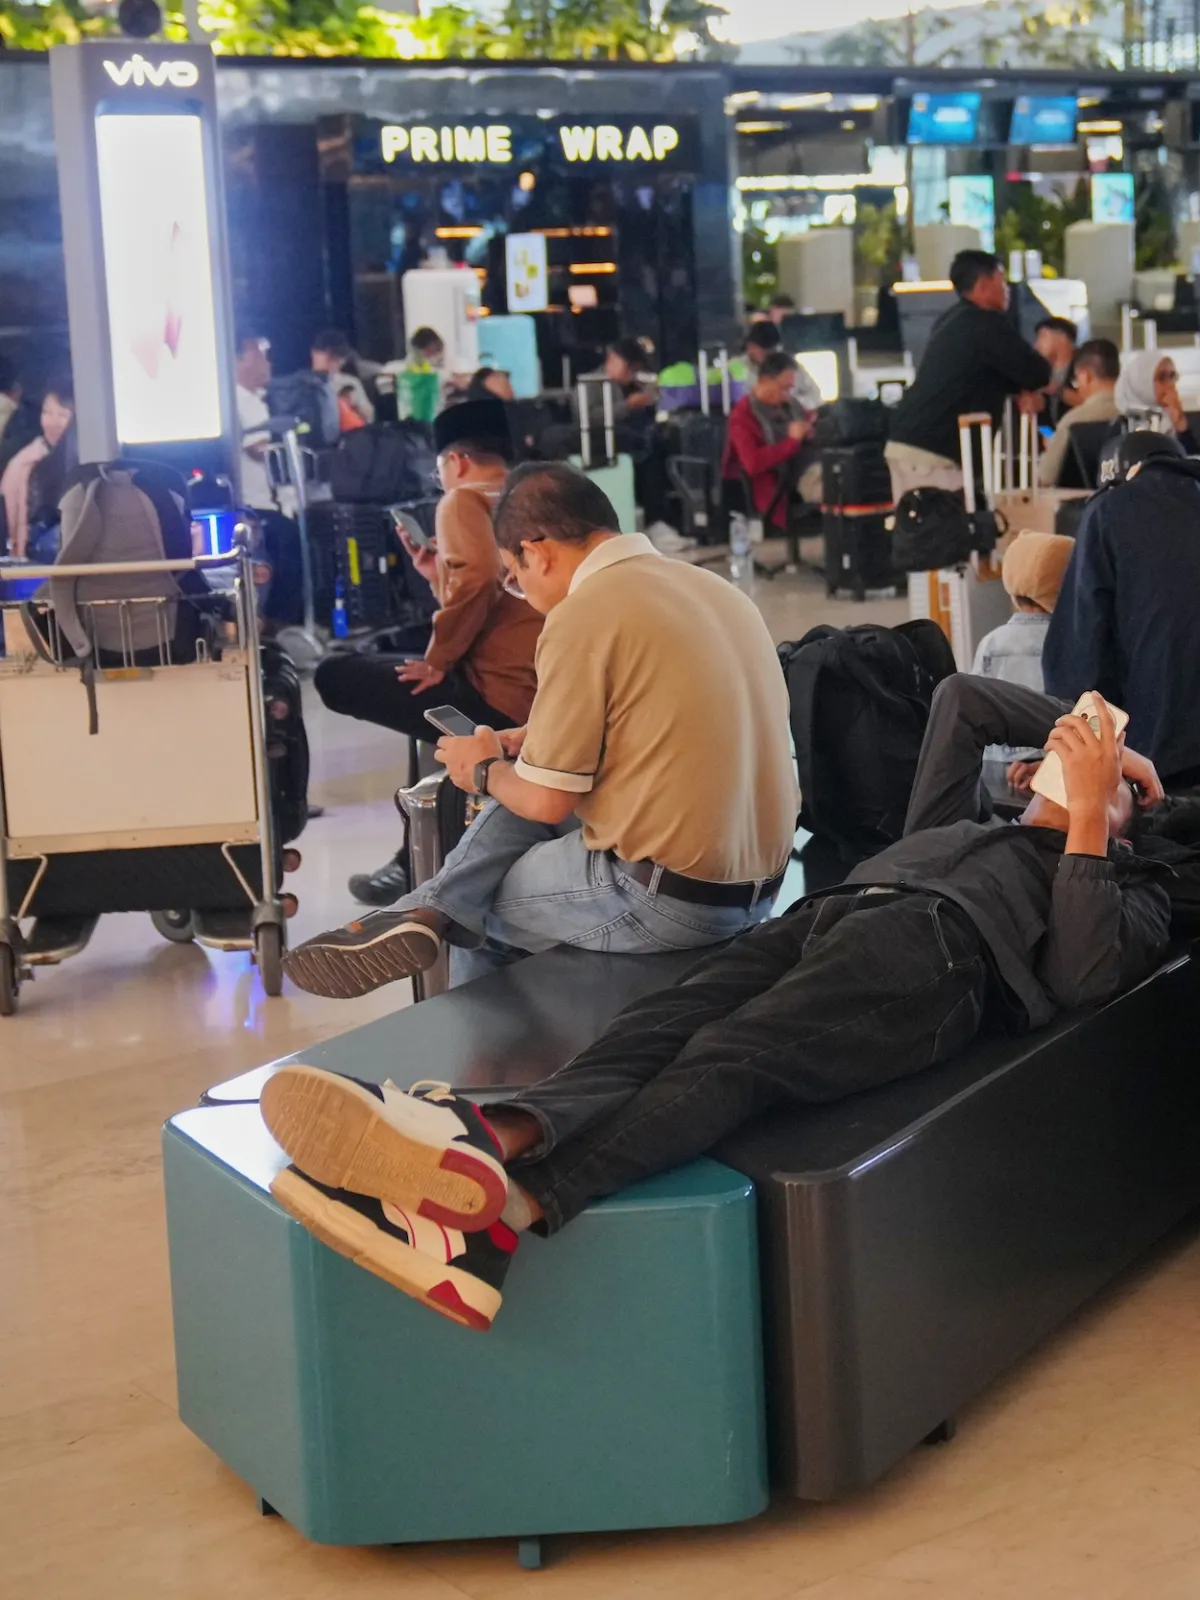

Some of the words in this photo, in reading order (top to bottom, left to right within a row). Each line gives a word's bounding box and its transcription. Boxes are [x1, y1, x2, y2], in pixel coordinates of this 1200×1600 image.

[102, 53, 199, 87] vivo
[381, 125, 512, 163] PRIME
[559, 125, 678, 162] WRAP
